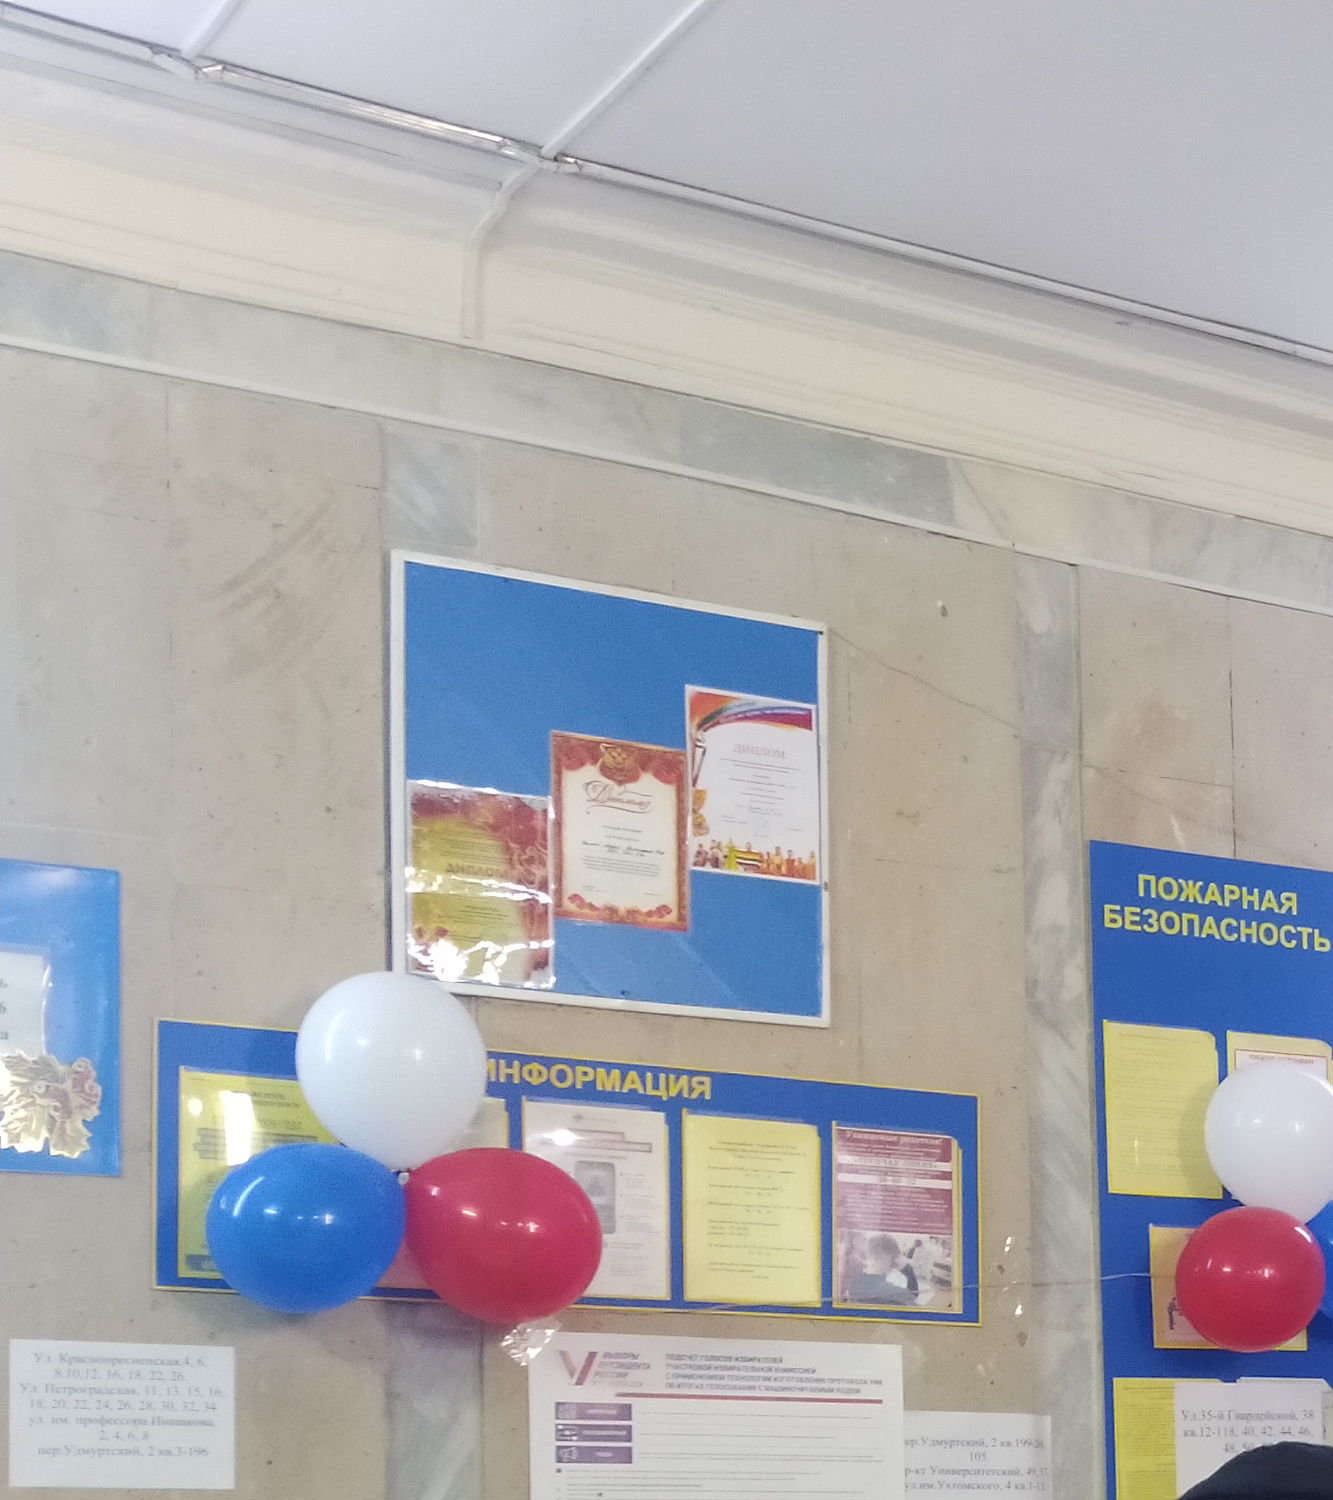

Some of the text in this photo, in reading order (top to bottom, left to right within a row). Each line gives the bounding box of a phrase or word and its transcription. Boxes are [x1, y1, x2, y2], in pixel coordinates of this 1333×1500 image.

[1137, 873, 1298, 916] ПОЖАРНАЯ
[1102, 904, 1331, 953] БЕЗОПАСНОСТЬ
[904, 1436, 989, 1449] ер.Удмуртский,
[904, 1468, 926, 1478] р-кт
[929, 1465, 1023, 1478] Университетский,
